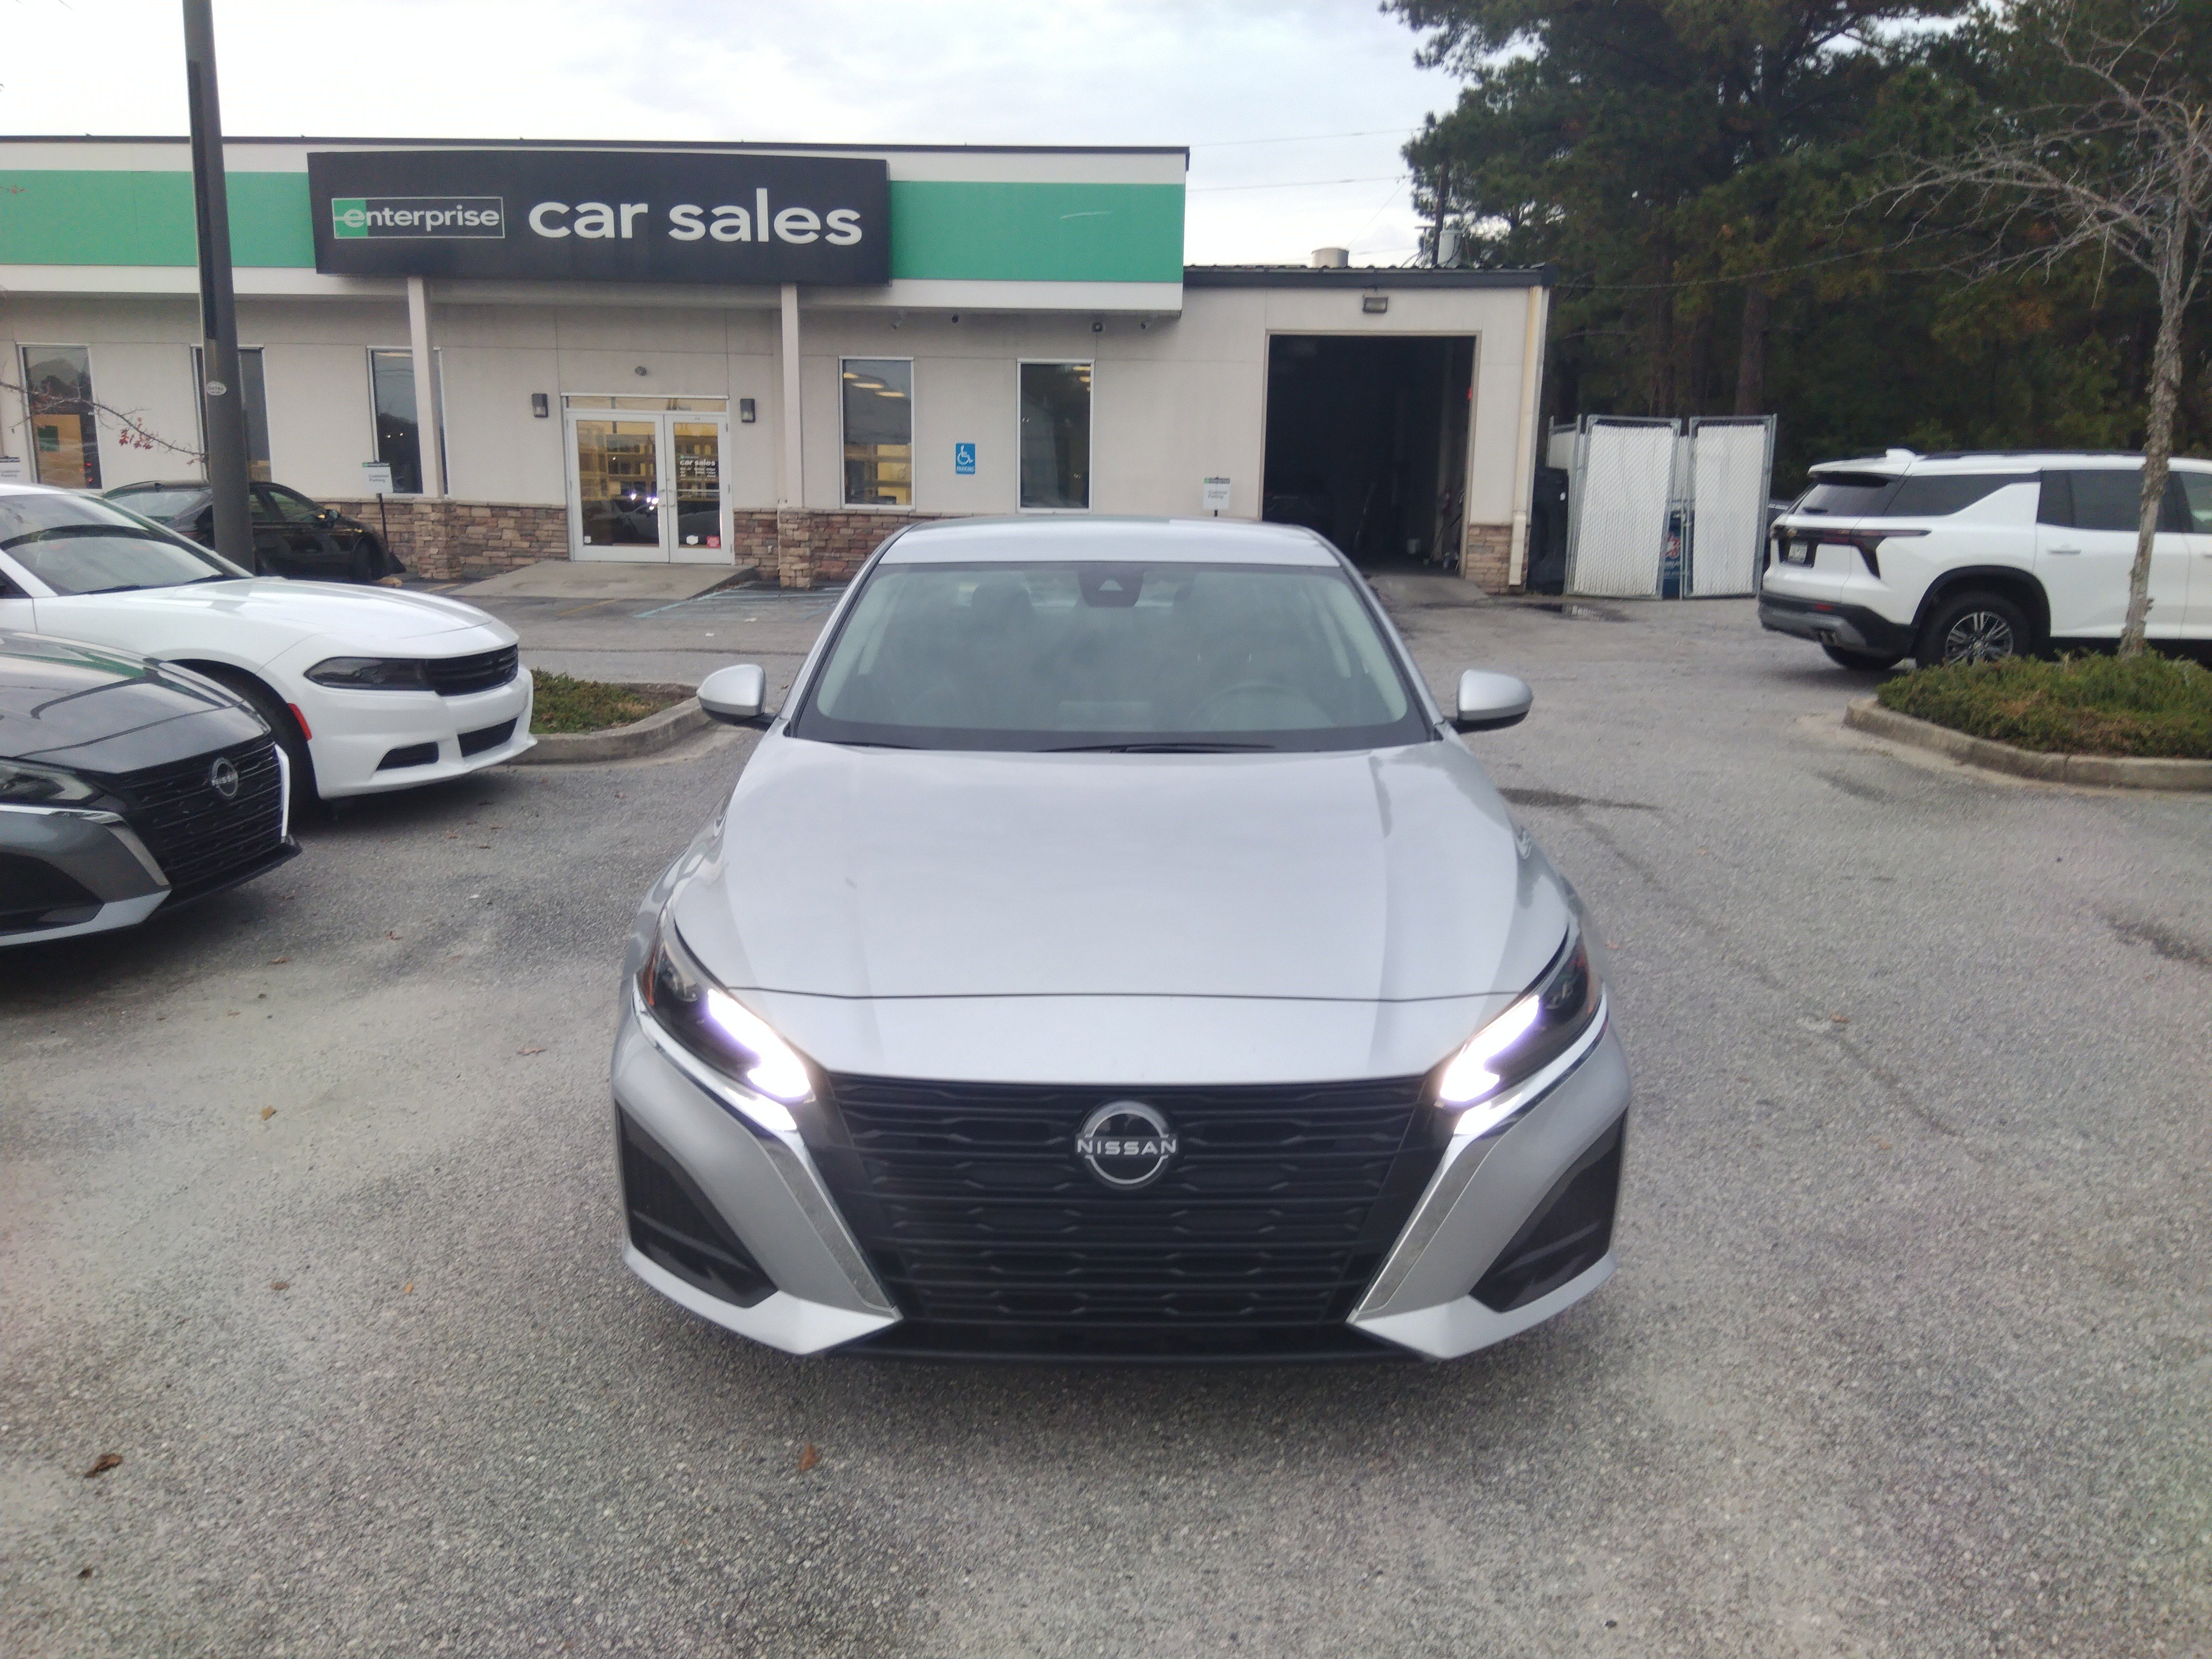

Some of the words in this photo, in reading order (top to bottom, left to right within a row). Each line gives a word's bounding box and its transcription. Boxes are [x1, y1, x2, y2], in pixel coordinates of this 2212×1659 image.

[343, 205, 500, 231] enterprise
[529, 202, 648, 238] car
[668, 188, 862, 246] sales
[1077, 1138, 1176, 1155] NISSAN
